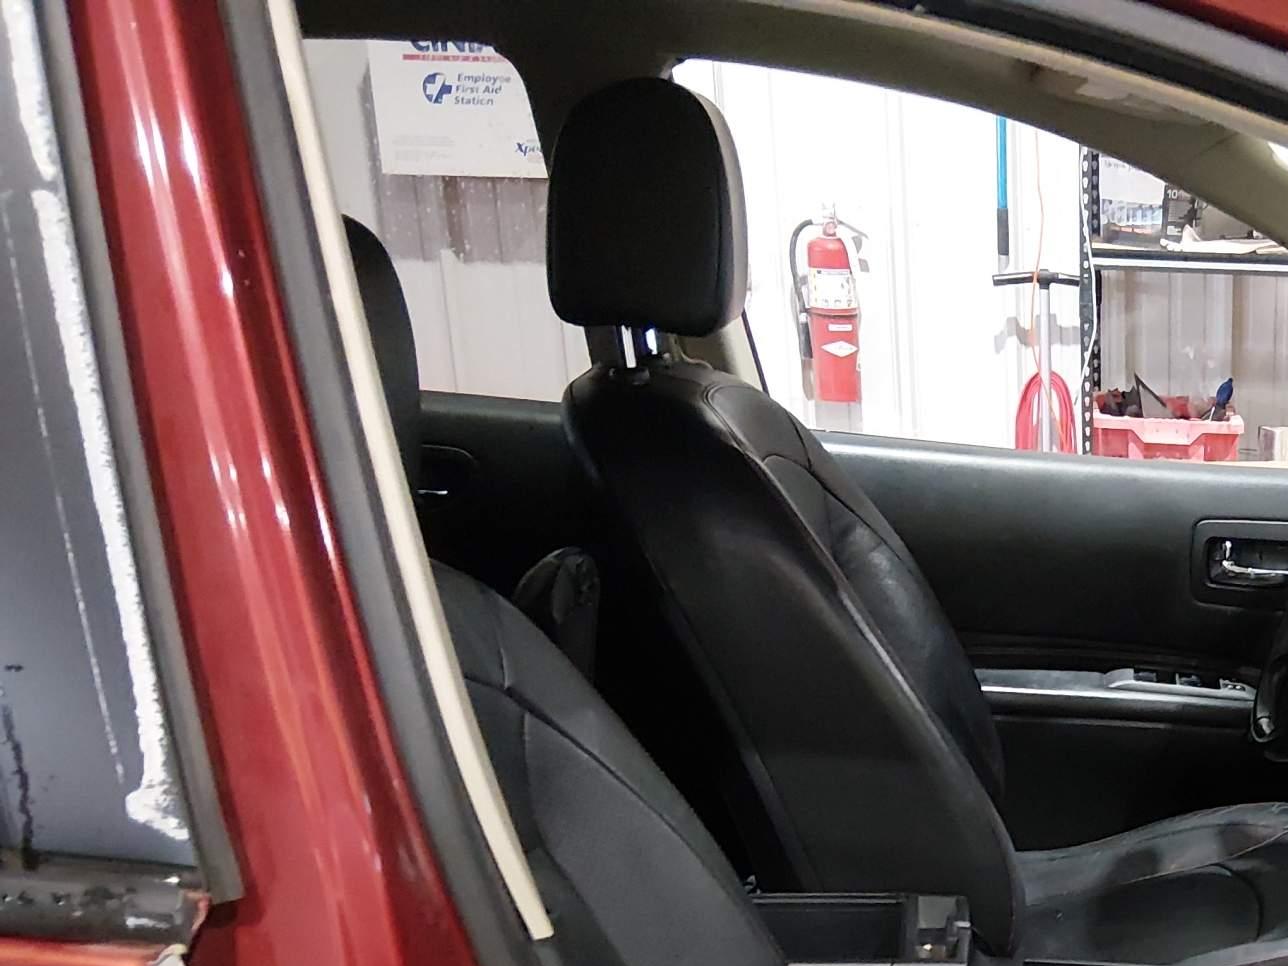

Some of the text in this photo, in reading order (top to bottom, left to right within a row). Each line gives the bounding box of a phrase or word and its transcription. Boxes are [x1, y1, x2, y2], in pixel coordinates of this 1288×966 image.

[455, 84, 503, 95] First Aid
[454, 95, 495, 106] Station
